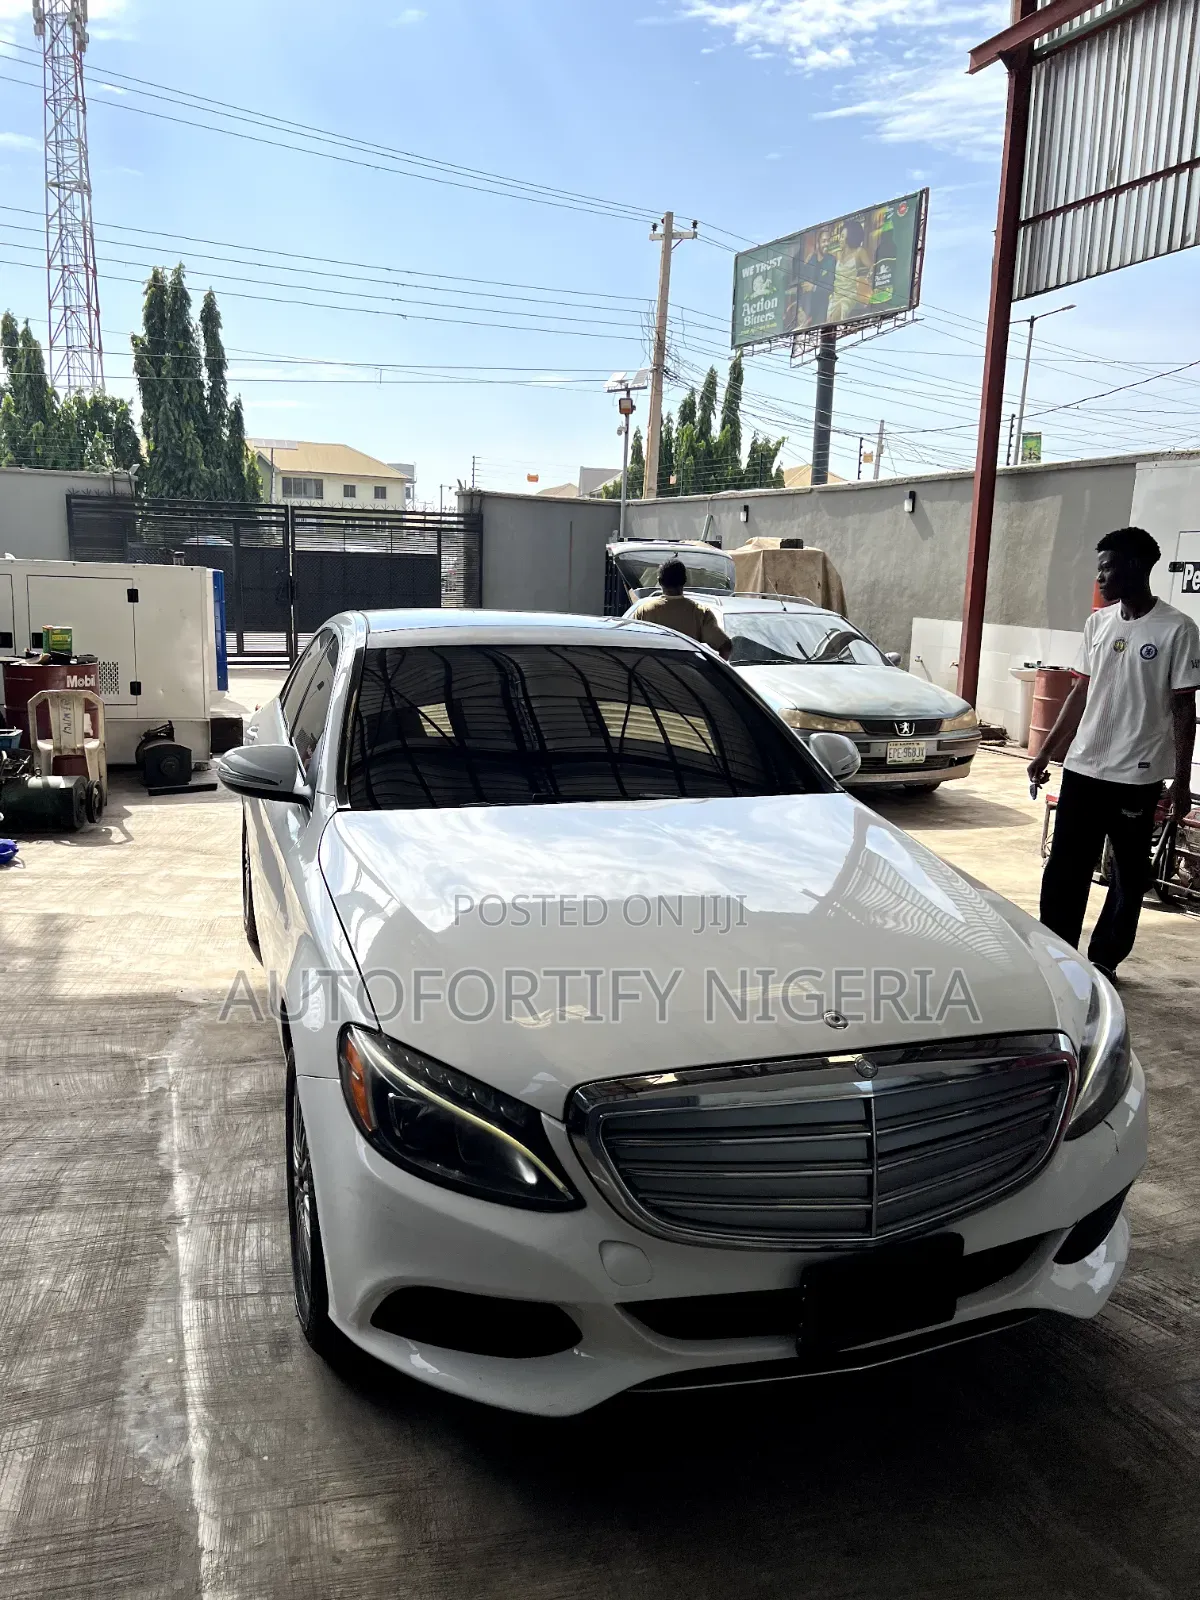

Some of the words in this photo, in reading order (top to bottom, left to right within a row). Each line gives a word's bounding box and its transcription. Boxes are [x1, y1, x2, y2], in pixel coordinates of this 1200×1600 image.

[742, 265, 755, 278] WE
[755, 256, 783, 274] TRUST
[742, 297, 778, 317] Action
[743, 311, 775, 327] Bitters
[66, 674, 96, 688] Mobil
